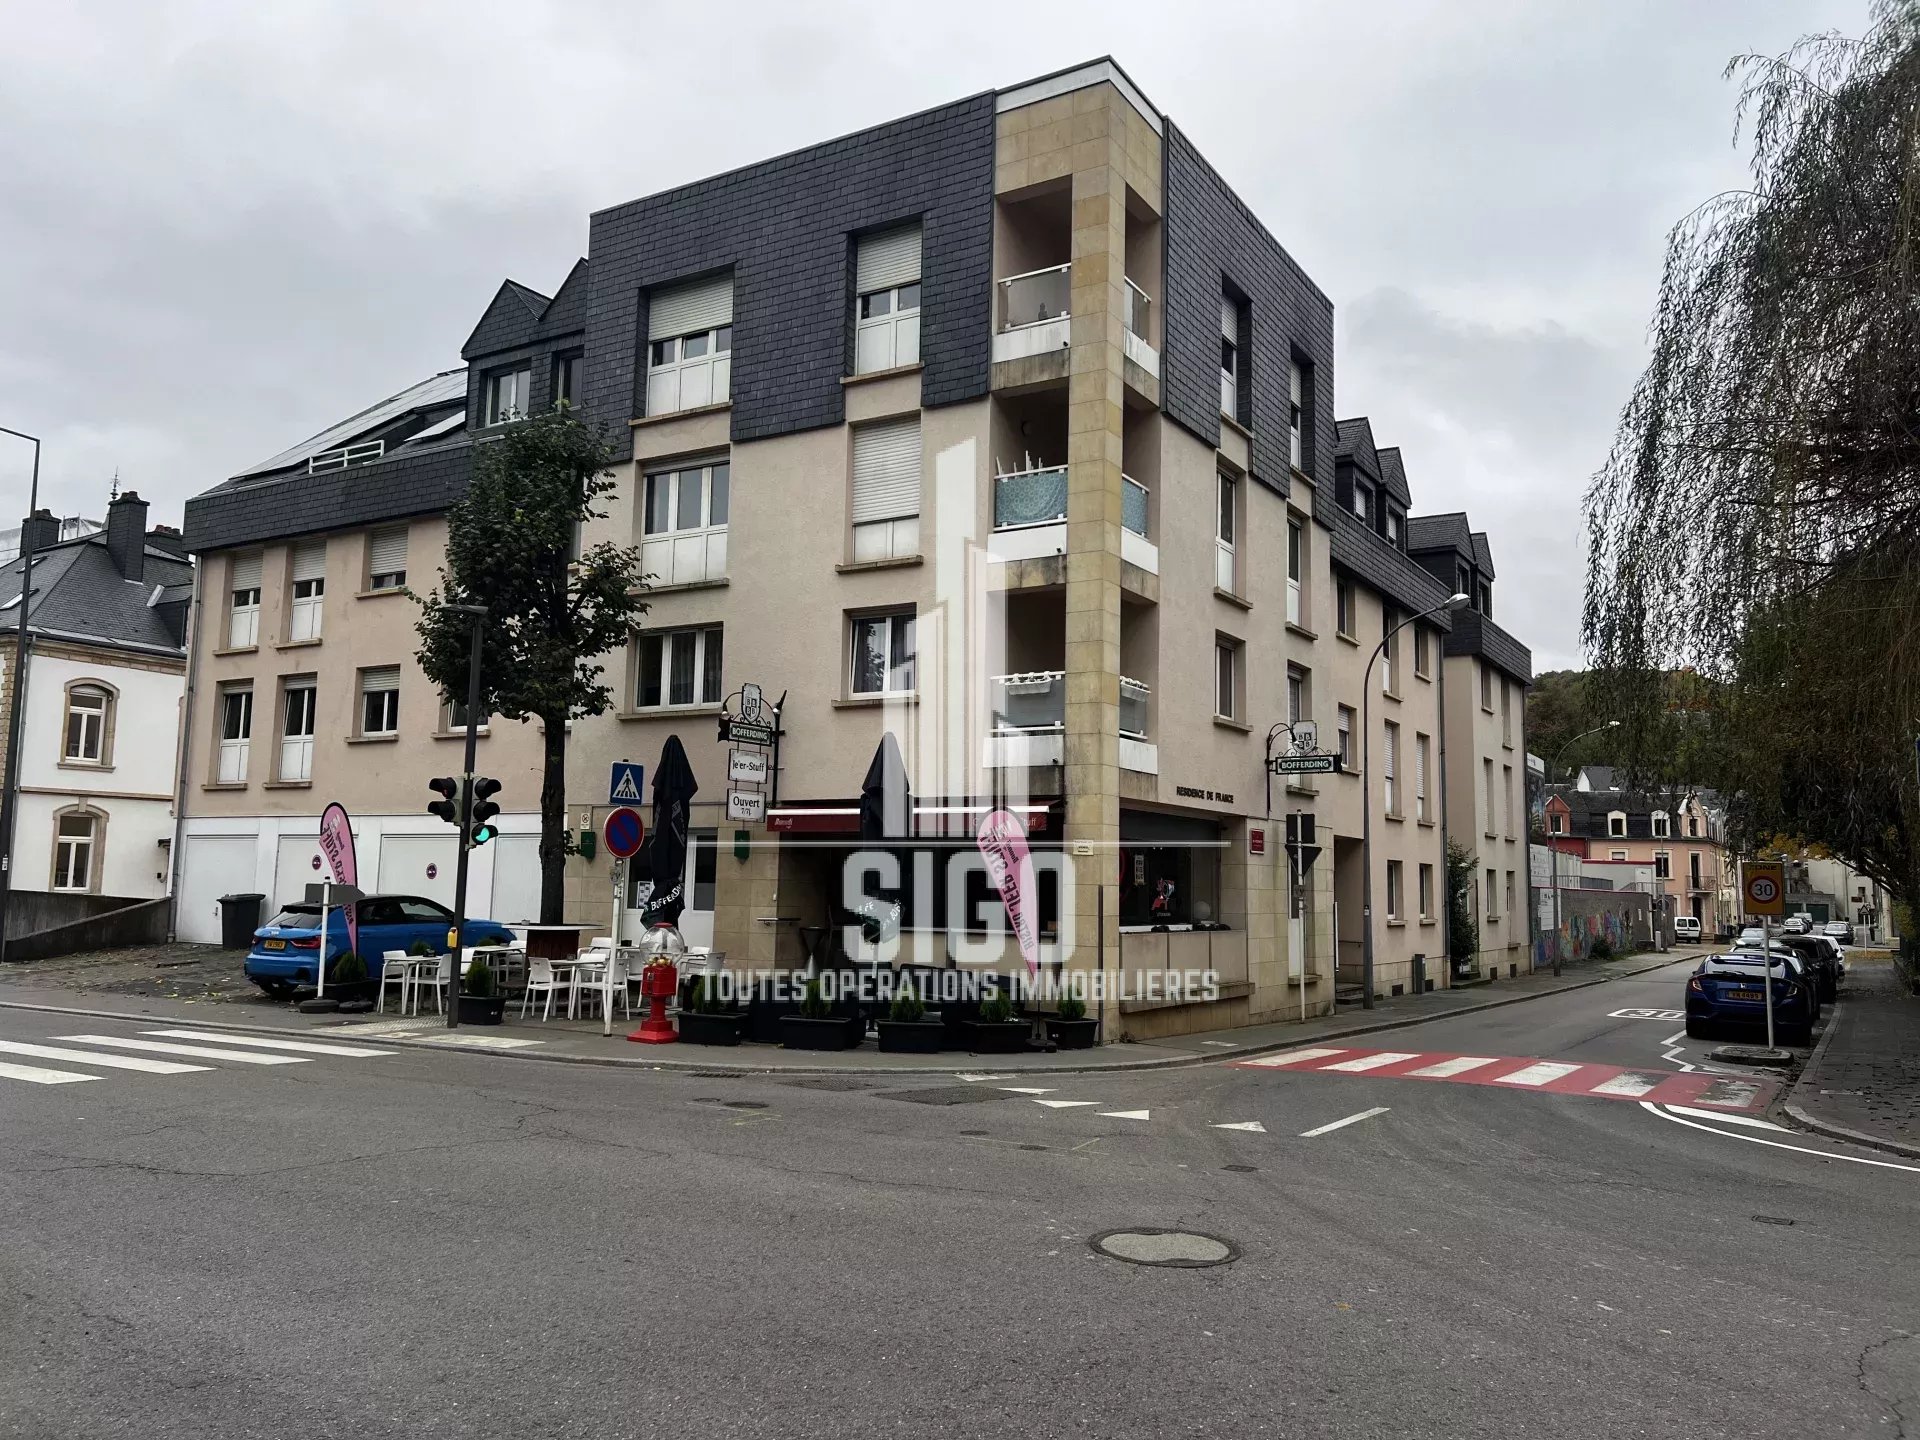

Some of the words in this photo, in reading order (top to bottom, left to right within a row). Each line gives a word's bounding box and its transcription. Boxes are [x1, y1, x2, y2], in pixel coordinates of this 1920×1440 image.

[732, 726, 767, 740] BOFFERDING
[1281, 760, 1329, 770] BOFFERDING
[1176, 785, 1205, 800] RESIDENCE
[1206, 791, 1214, 801] DE
[1215, 792, 1234, 804] FRANCE
[733, 796, 760, 808] Ouvert
[1754, 884, 1773, 896] 30
[1628, 1010, 1685, 1019] 30
